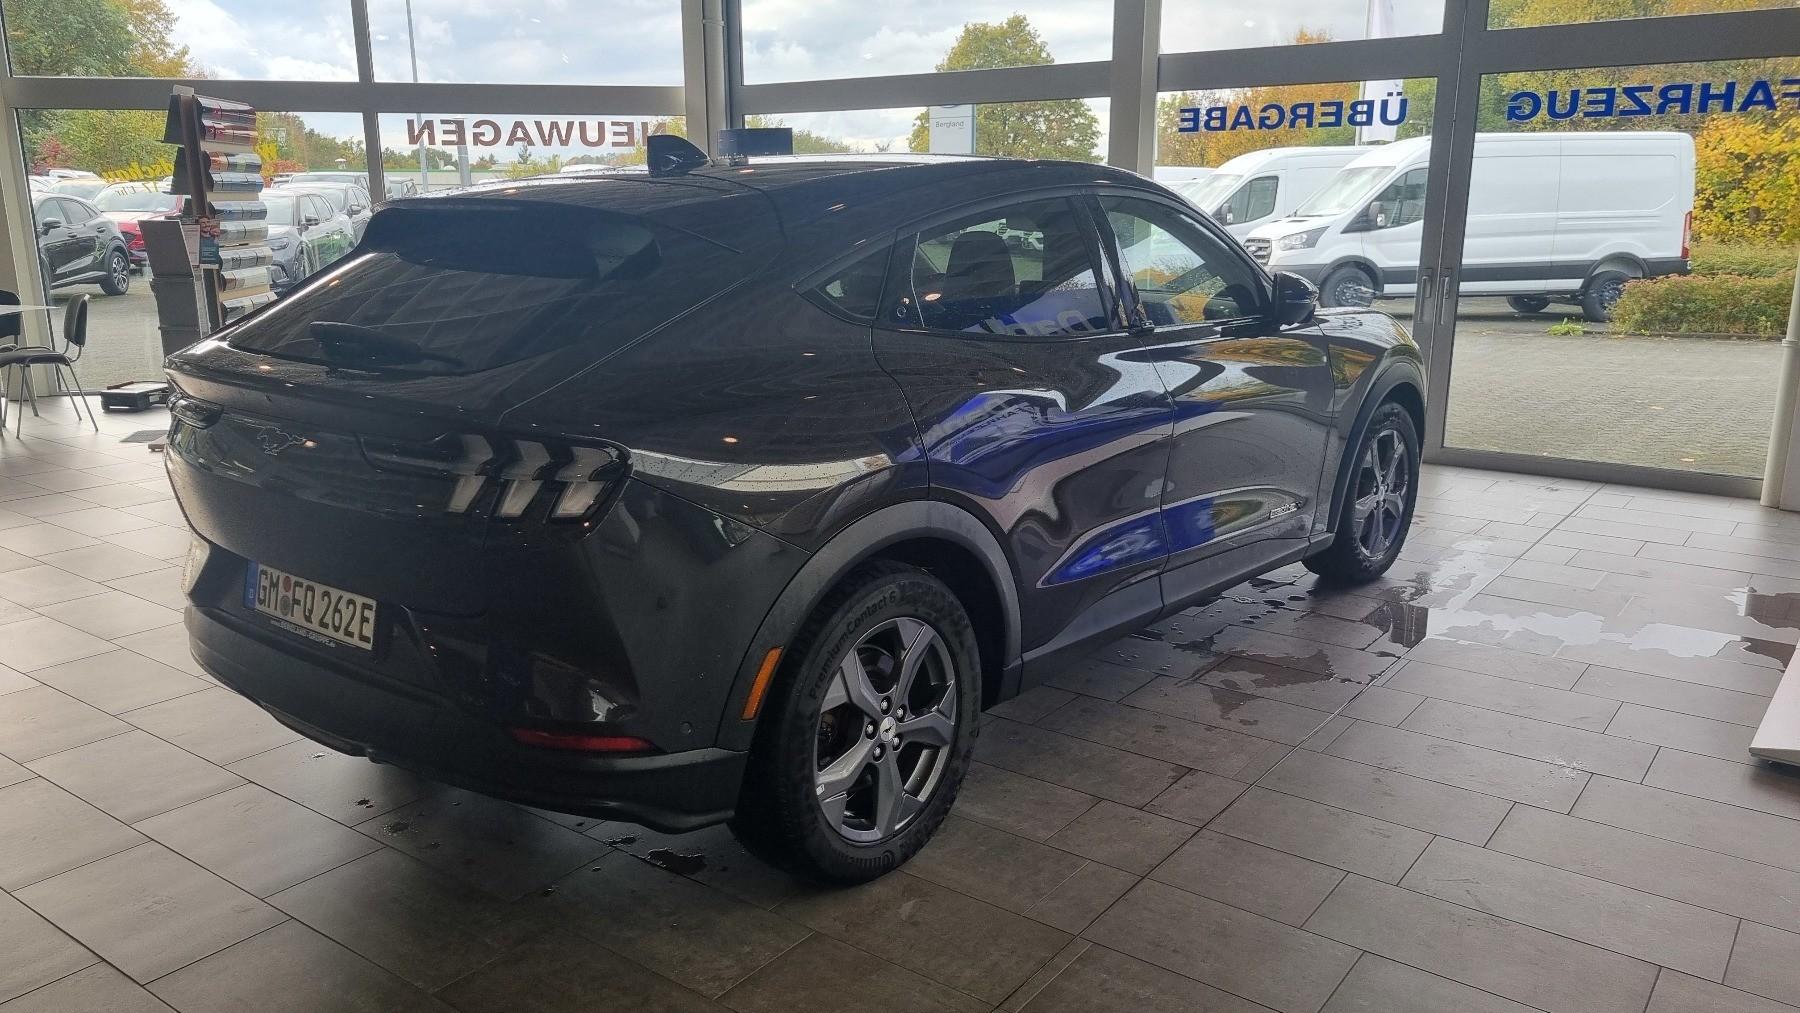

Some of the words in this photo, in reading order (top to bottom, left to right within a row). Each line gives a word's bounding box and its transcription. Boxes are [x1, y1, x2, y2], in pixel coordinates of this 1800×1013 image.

[257, 570, 280, 611] GM
[291, 581, 315, 624] FQ
[318, 591, 373, 643] 262E
[809, 597, 887, 699] PremiumContact
[888, 591, 899, 605] 6
